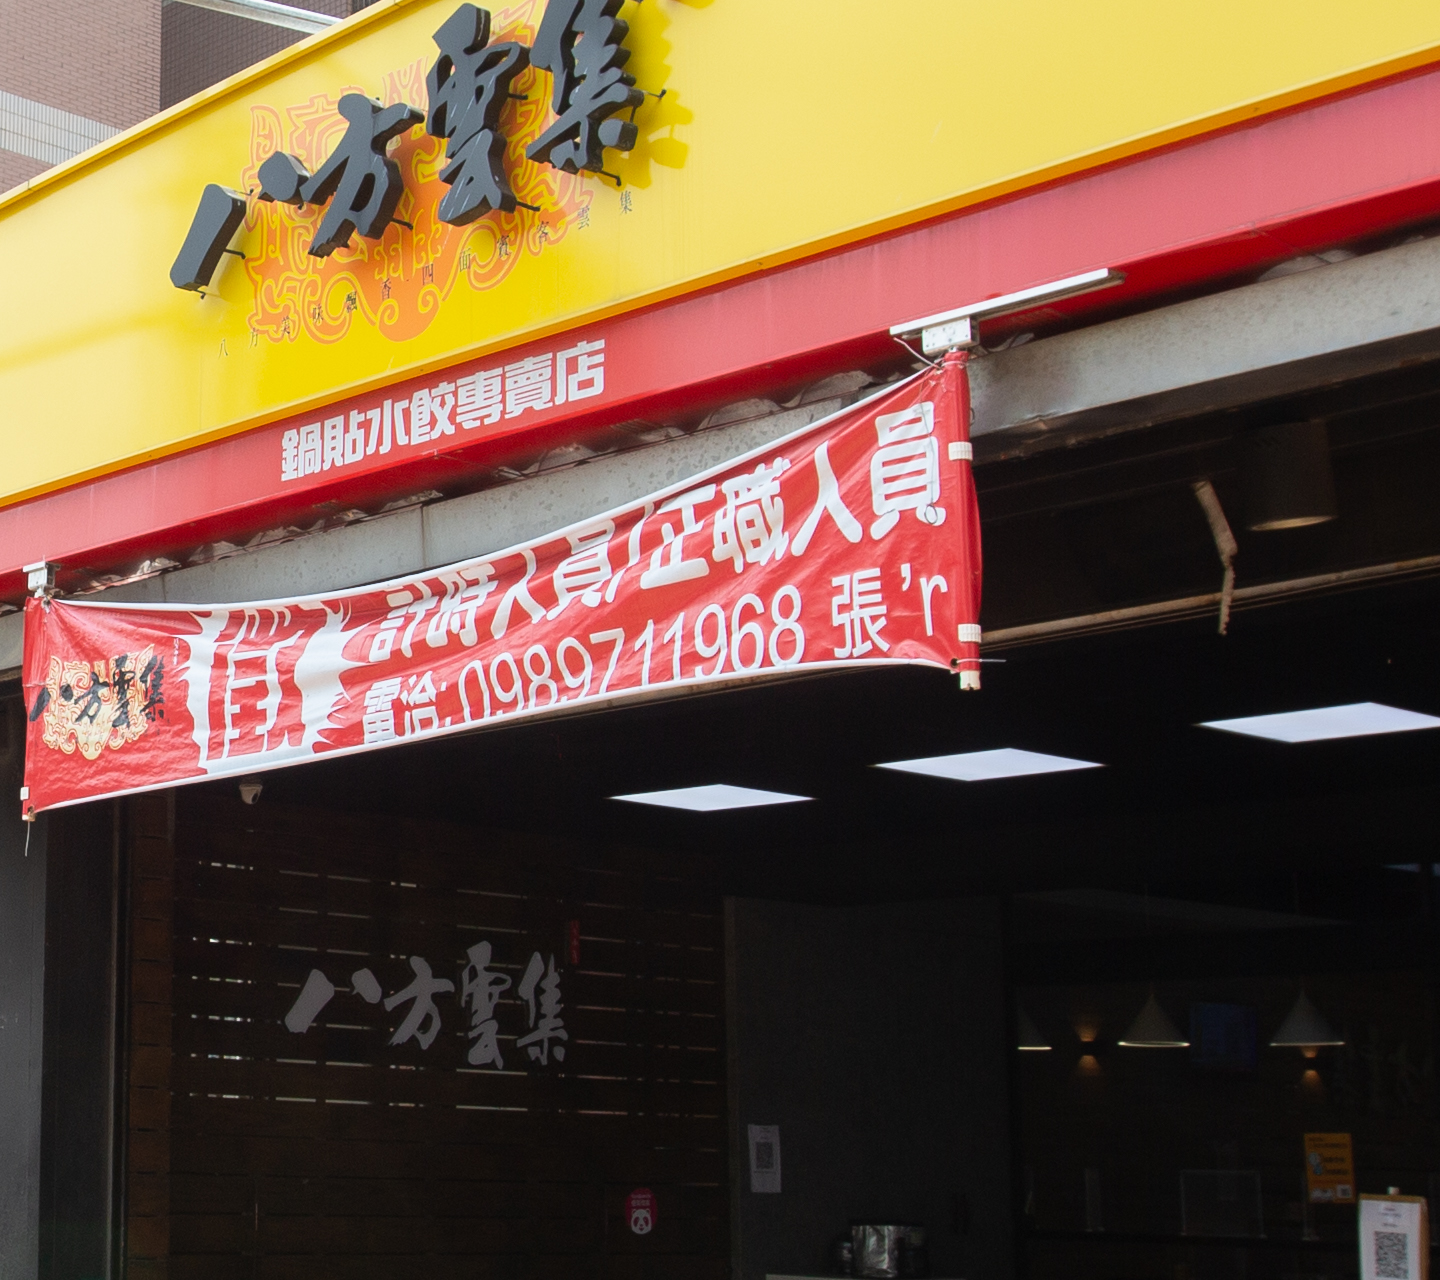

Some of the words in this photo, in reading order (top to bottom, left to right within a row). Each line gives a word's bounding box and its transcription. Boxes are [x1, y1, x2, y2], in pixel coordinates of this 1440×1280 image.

[281, 338, 606, 482] 鍋貼水餃專賣店
[368, 401, 948, 664] 計時人員/正職人員
[285, 940, 570, 1068] 八方雲集
